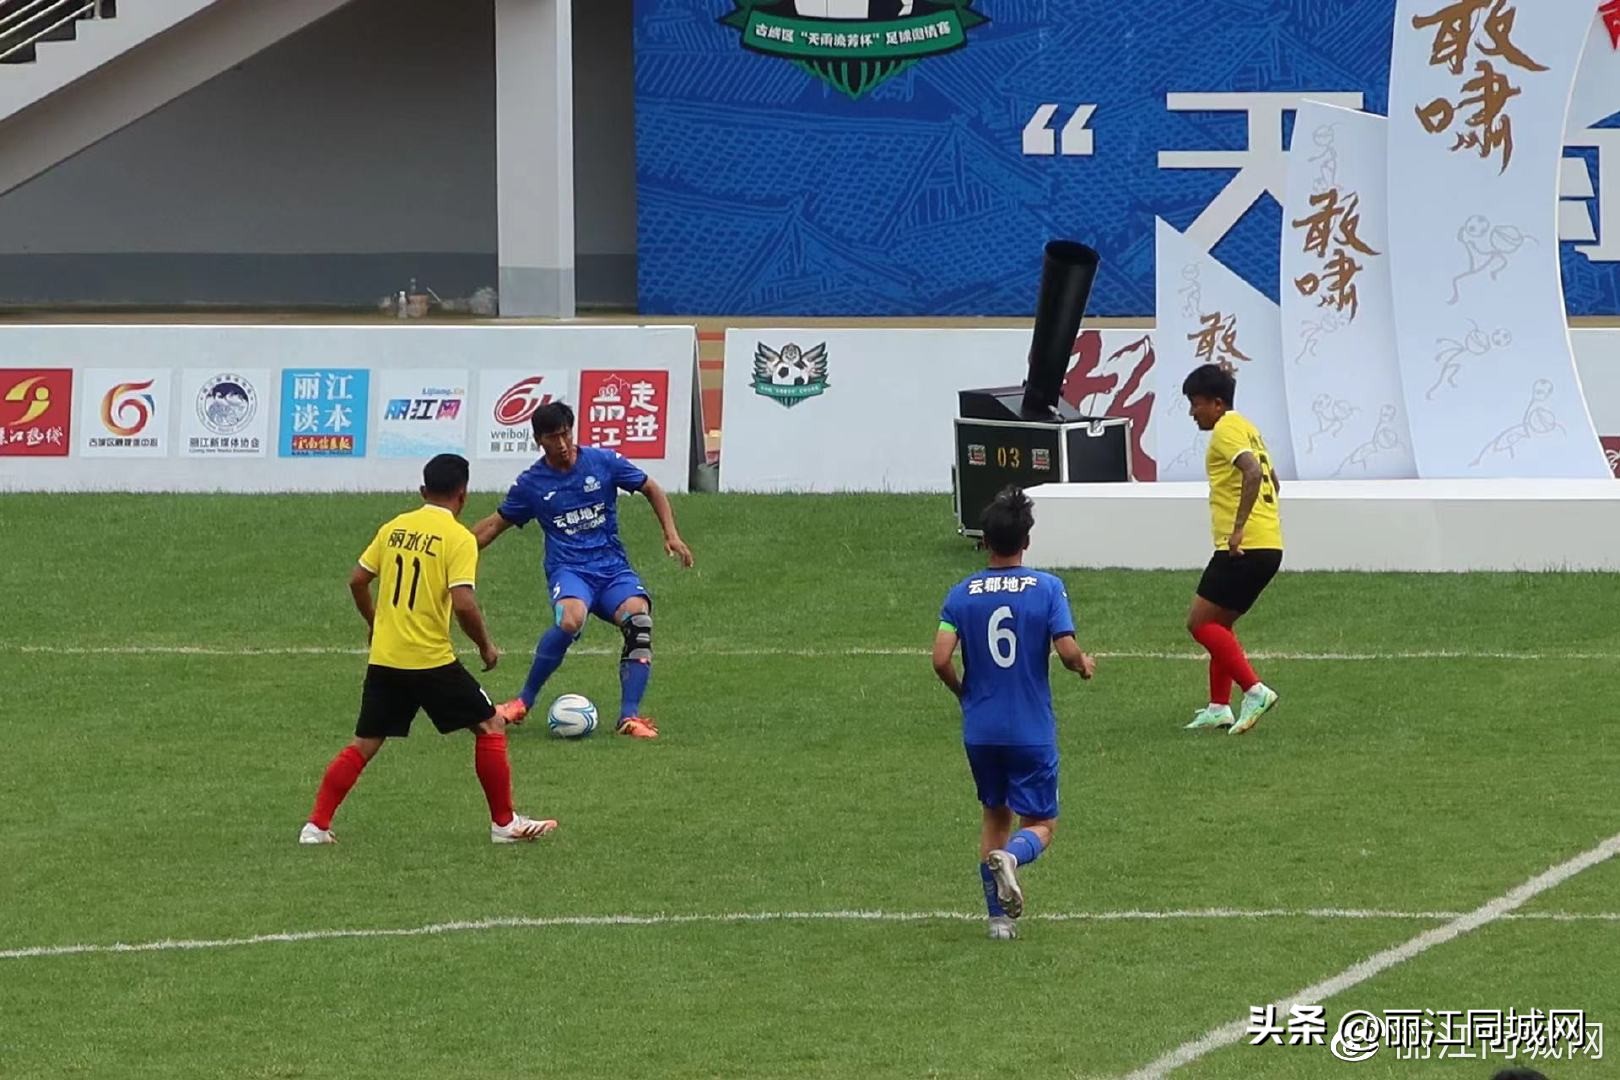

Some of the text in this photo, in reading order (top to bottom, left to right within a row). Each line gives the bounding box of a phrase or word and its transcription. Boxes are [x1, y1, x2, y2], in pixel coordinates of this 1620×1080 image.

[292, 372, 353, 400] 丽江
[291, 403, 353, 432] 读本
[384, 399, 461, 420] 丽江网
[625, 380, 659, 441] 走进
[997, 447, 1020, 467] 03
[392, 553, 421, 611] 11
[988, 606, 1017, 669] 6
